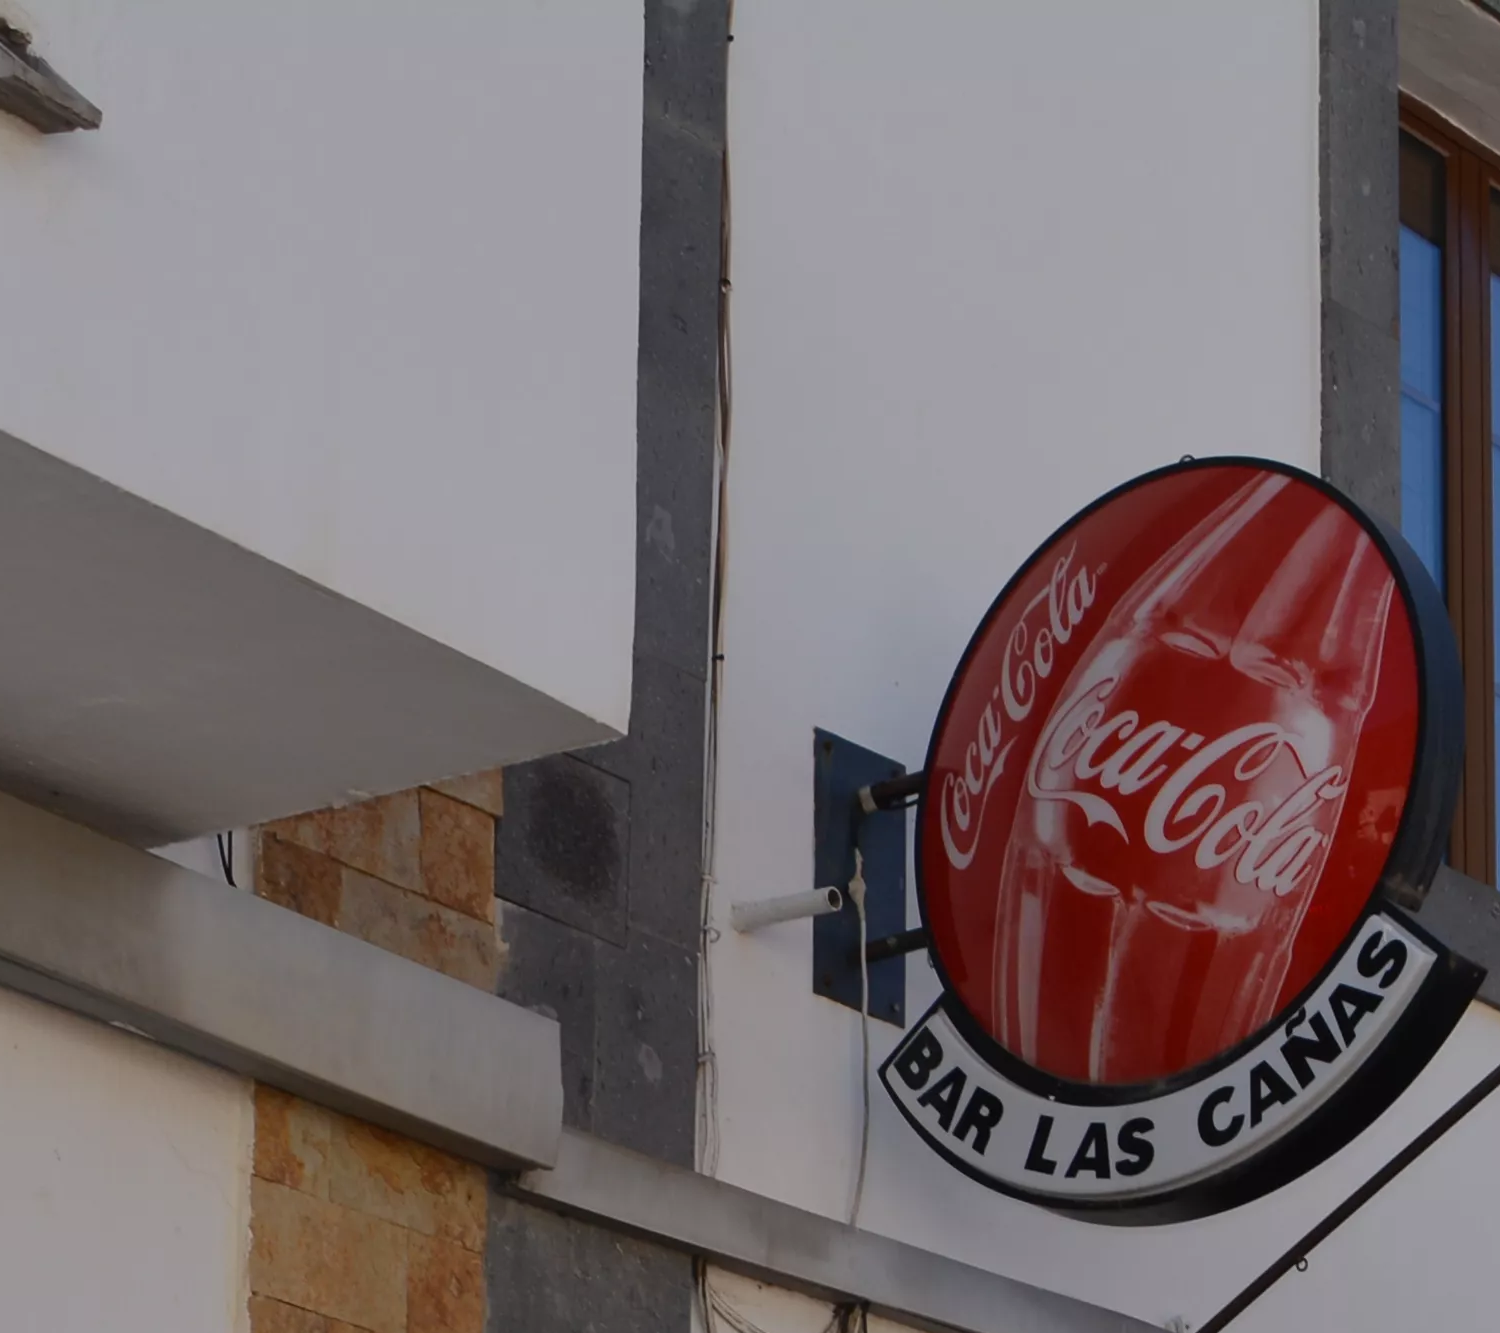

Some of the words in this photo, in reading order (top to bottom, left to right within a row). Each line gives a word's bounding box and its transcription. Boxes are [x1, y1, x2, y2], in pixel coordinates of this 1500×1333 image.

[939, 541, 1097, 870] Coca-Cola
[1028, 676, 1350, 898] Coca-Cola
[893, 1026, 1004, 1156] BAR
[1023, 1114, 1156, 1180] LAS
[1196, 928, 1409, 1148] CAÑAS
